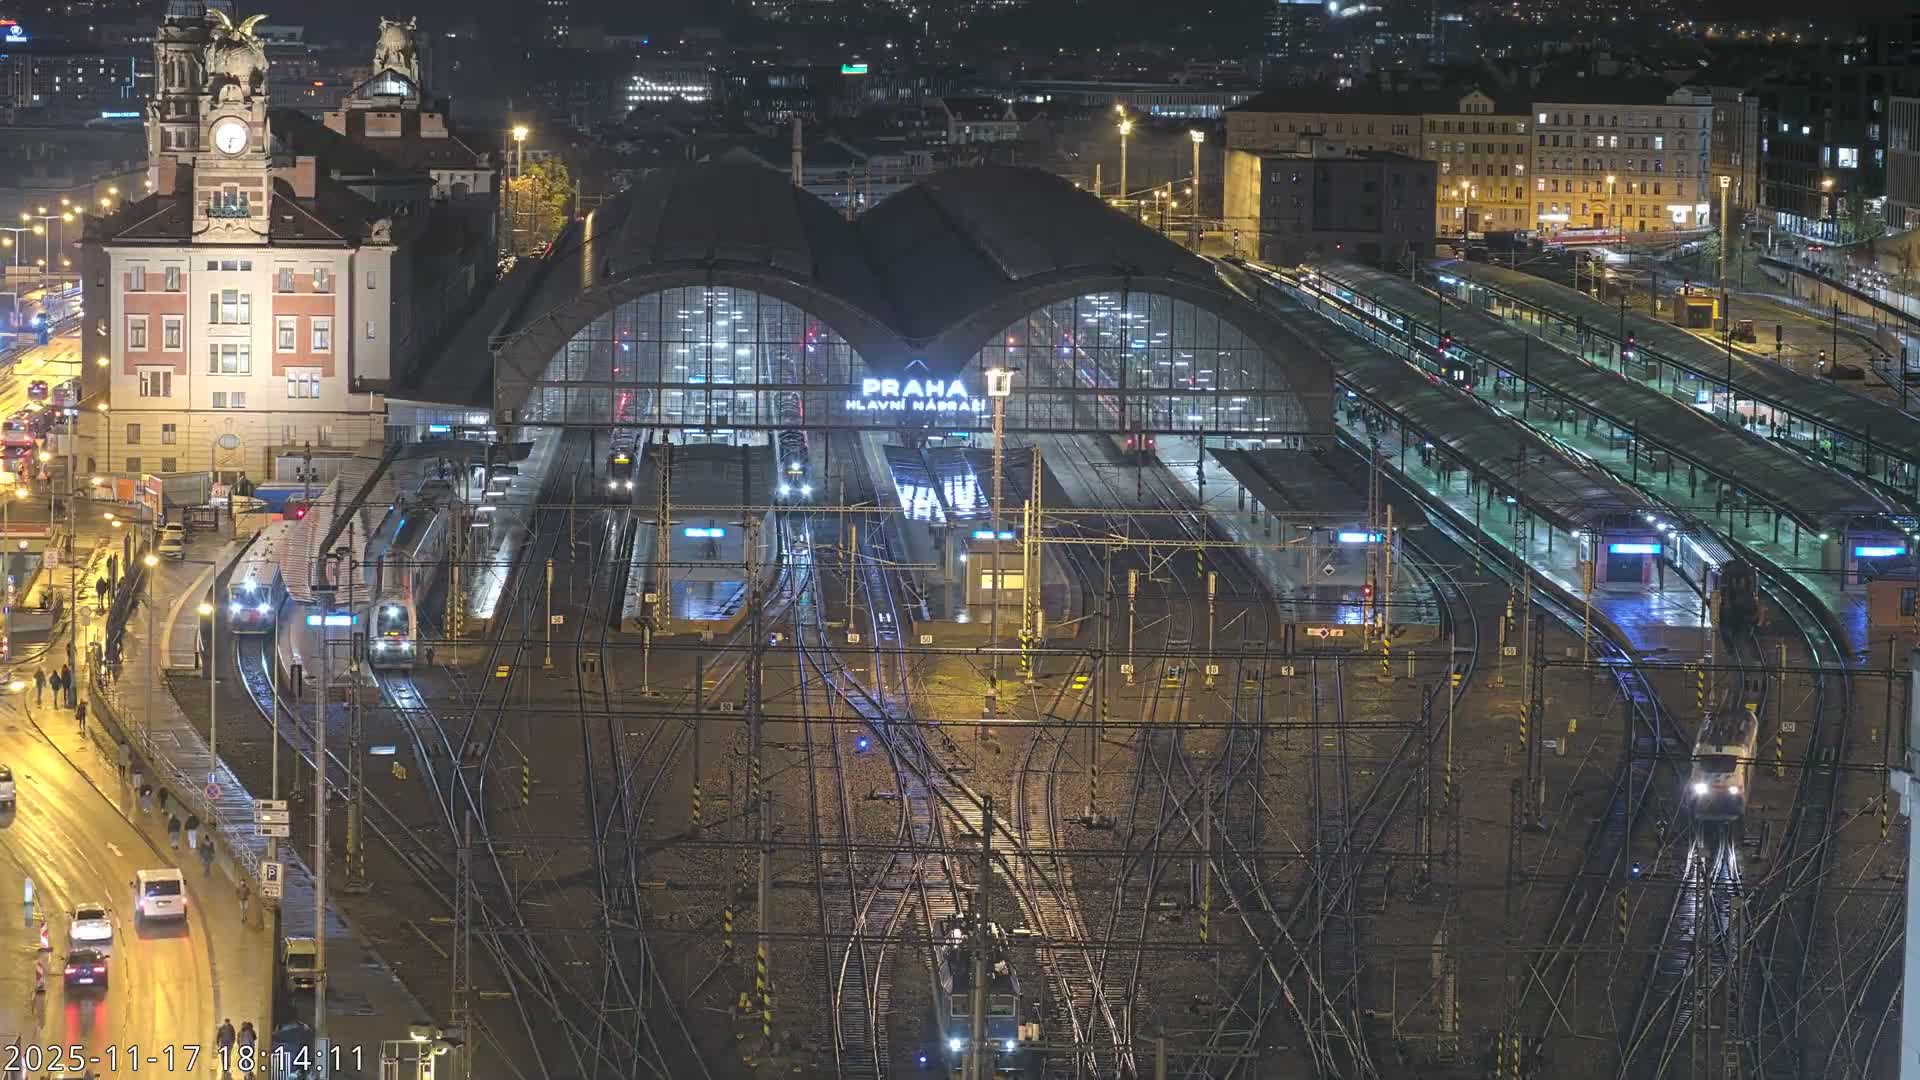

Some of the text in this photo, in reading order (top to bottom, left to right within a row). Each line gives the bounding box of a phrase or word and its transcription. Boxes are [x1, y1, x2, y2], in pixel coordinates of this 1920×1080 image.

[862, 378, 968, 397] PRAHA
[845, 397, 986, 412] HLAVNÍ NÁDRAŽÍ
